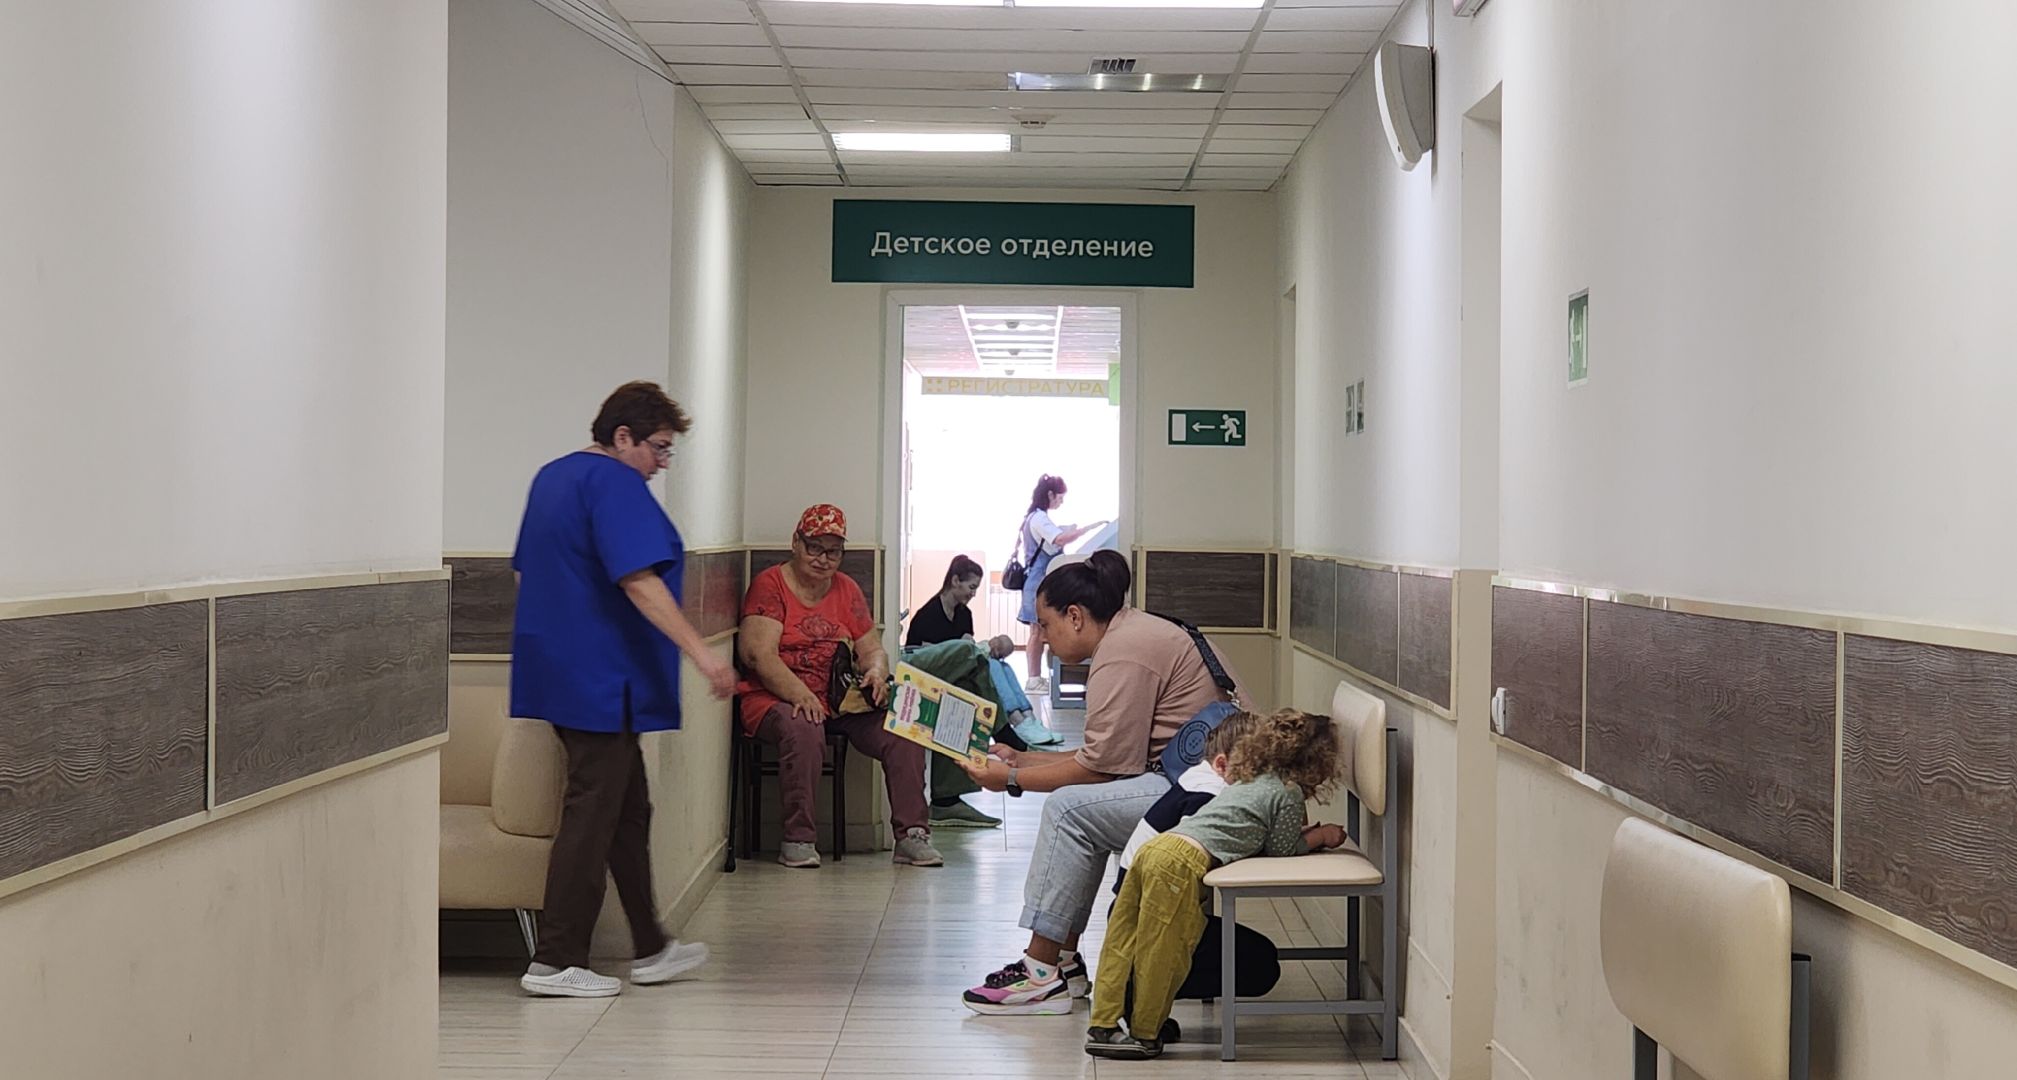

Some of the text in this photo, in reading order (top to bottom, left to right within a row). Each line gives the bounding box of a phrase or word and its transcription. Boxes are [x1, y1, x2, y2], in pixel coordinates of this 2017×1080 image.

[871, 232, 1153, 259] Детское отделение
[949, 379, 1105, 395] РЕГИСТРАТУРА
